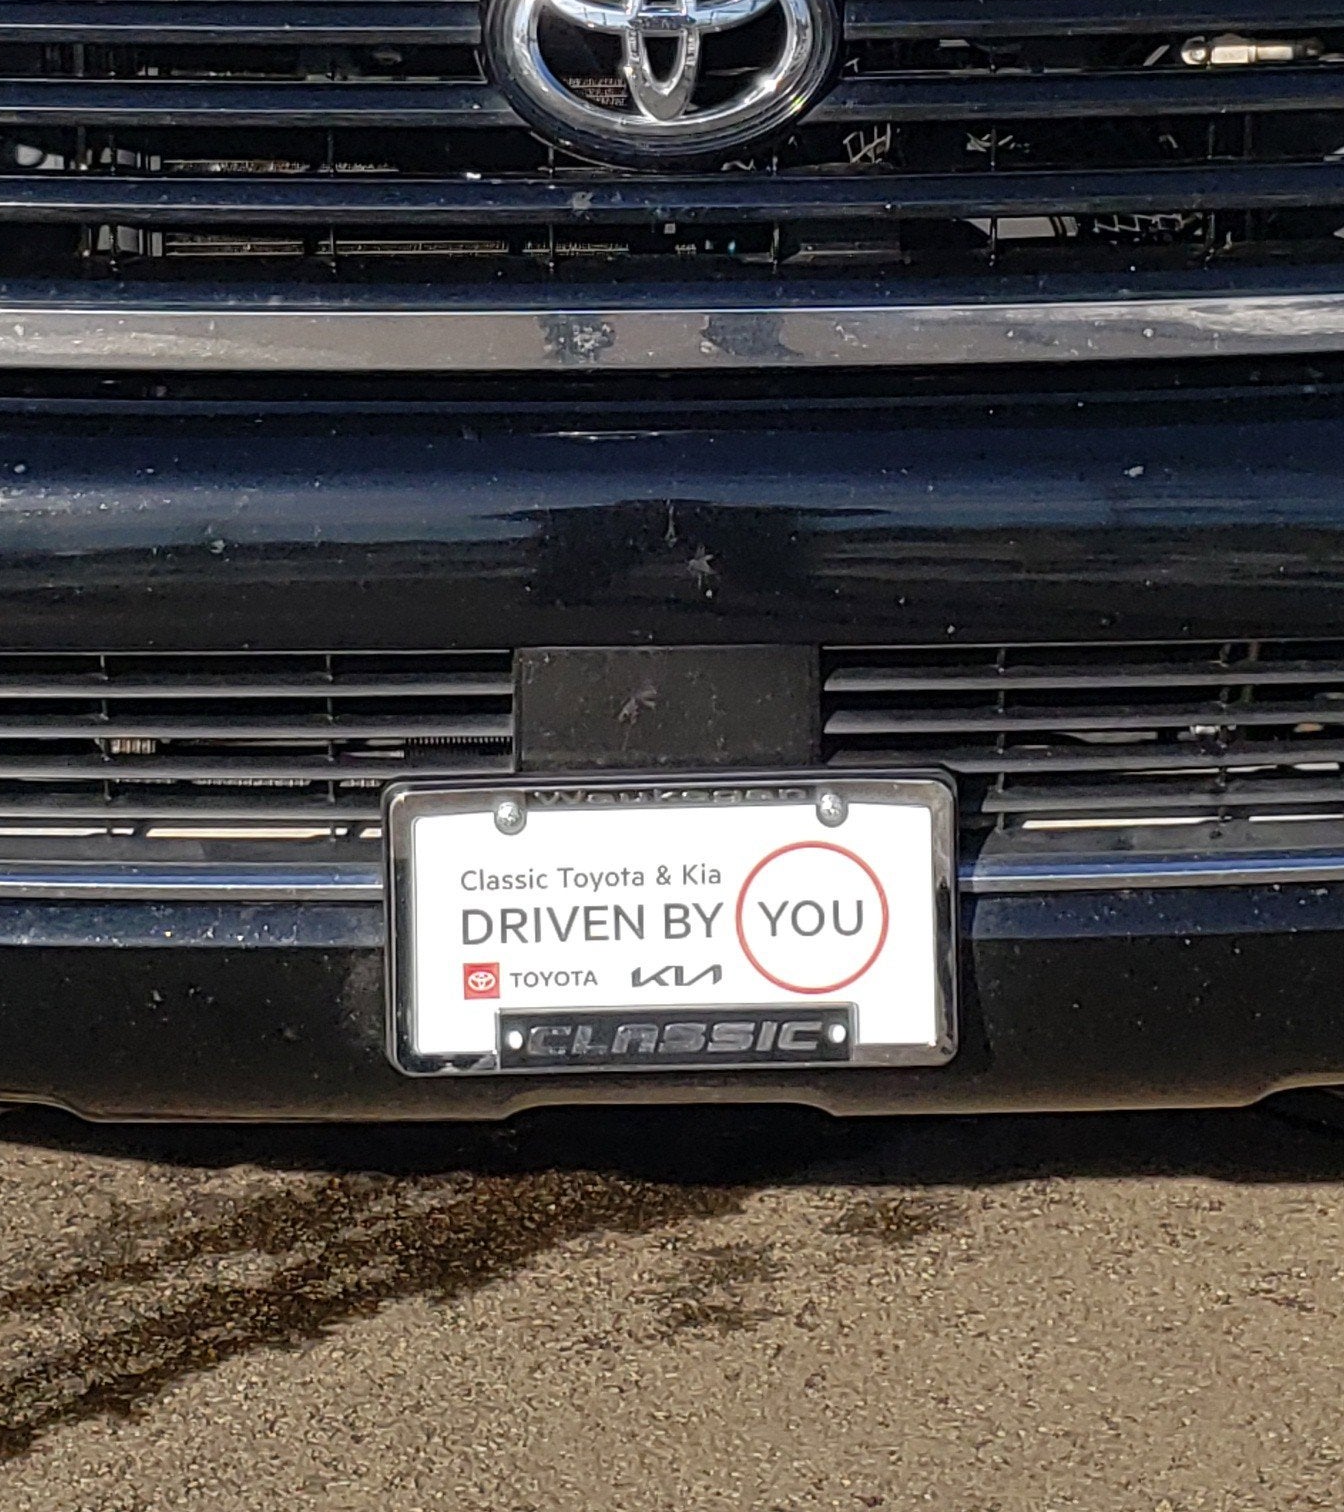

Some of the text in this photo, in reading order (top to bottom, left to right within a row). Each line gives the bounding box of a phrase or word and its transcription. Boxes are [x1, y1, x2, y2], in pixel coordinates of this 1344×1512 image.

[460, 862, 722, 893] Classic Toyota & Kia
[462, 899, 864, 945] DRIVEN BY YOU
[509, 970, 598, 988] TOYOTA
[527, 1020, 823, 1055] CLASSIC
